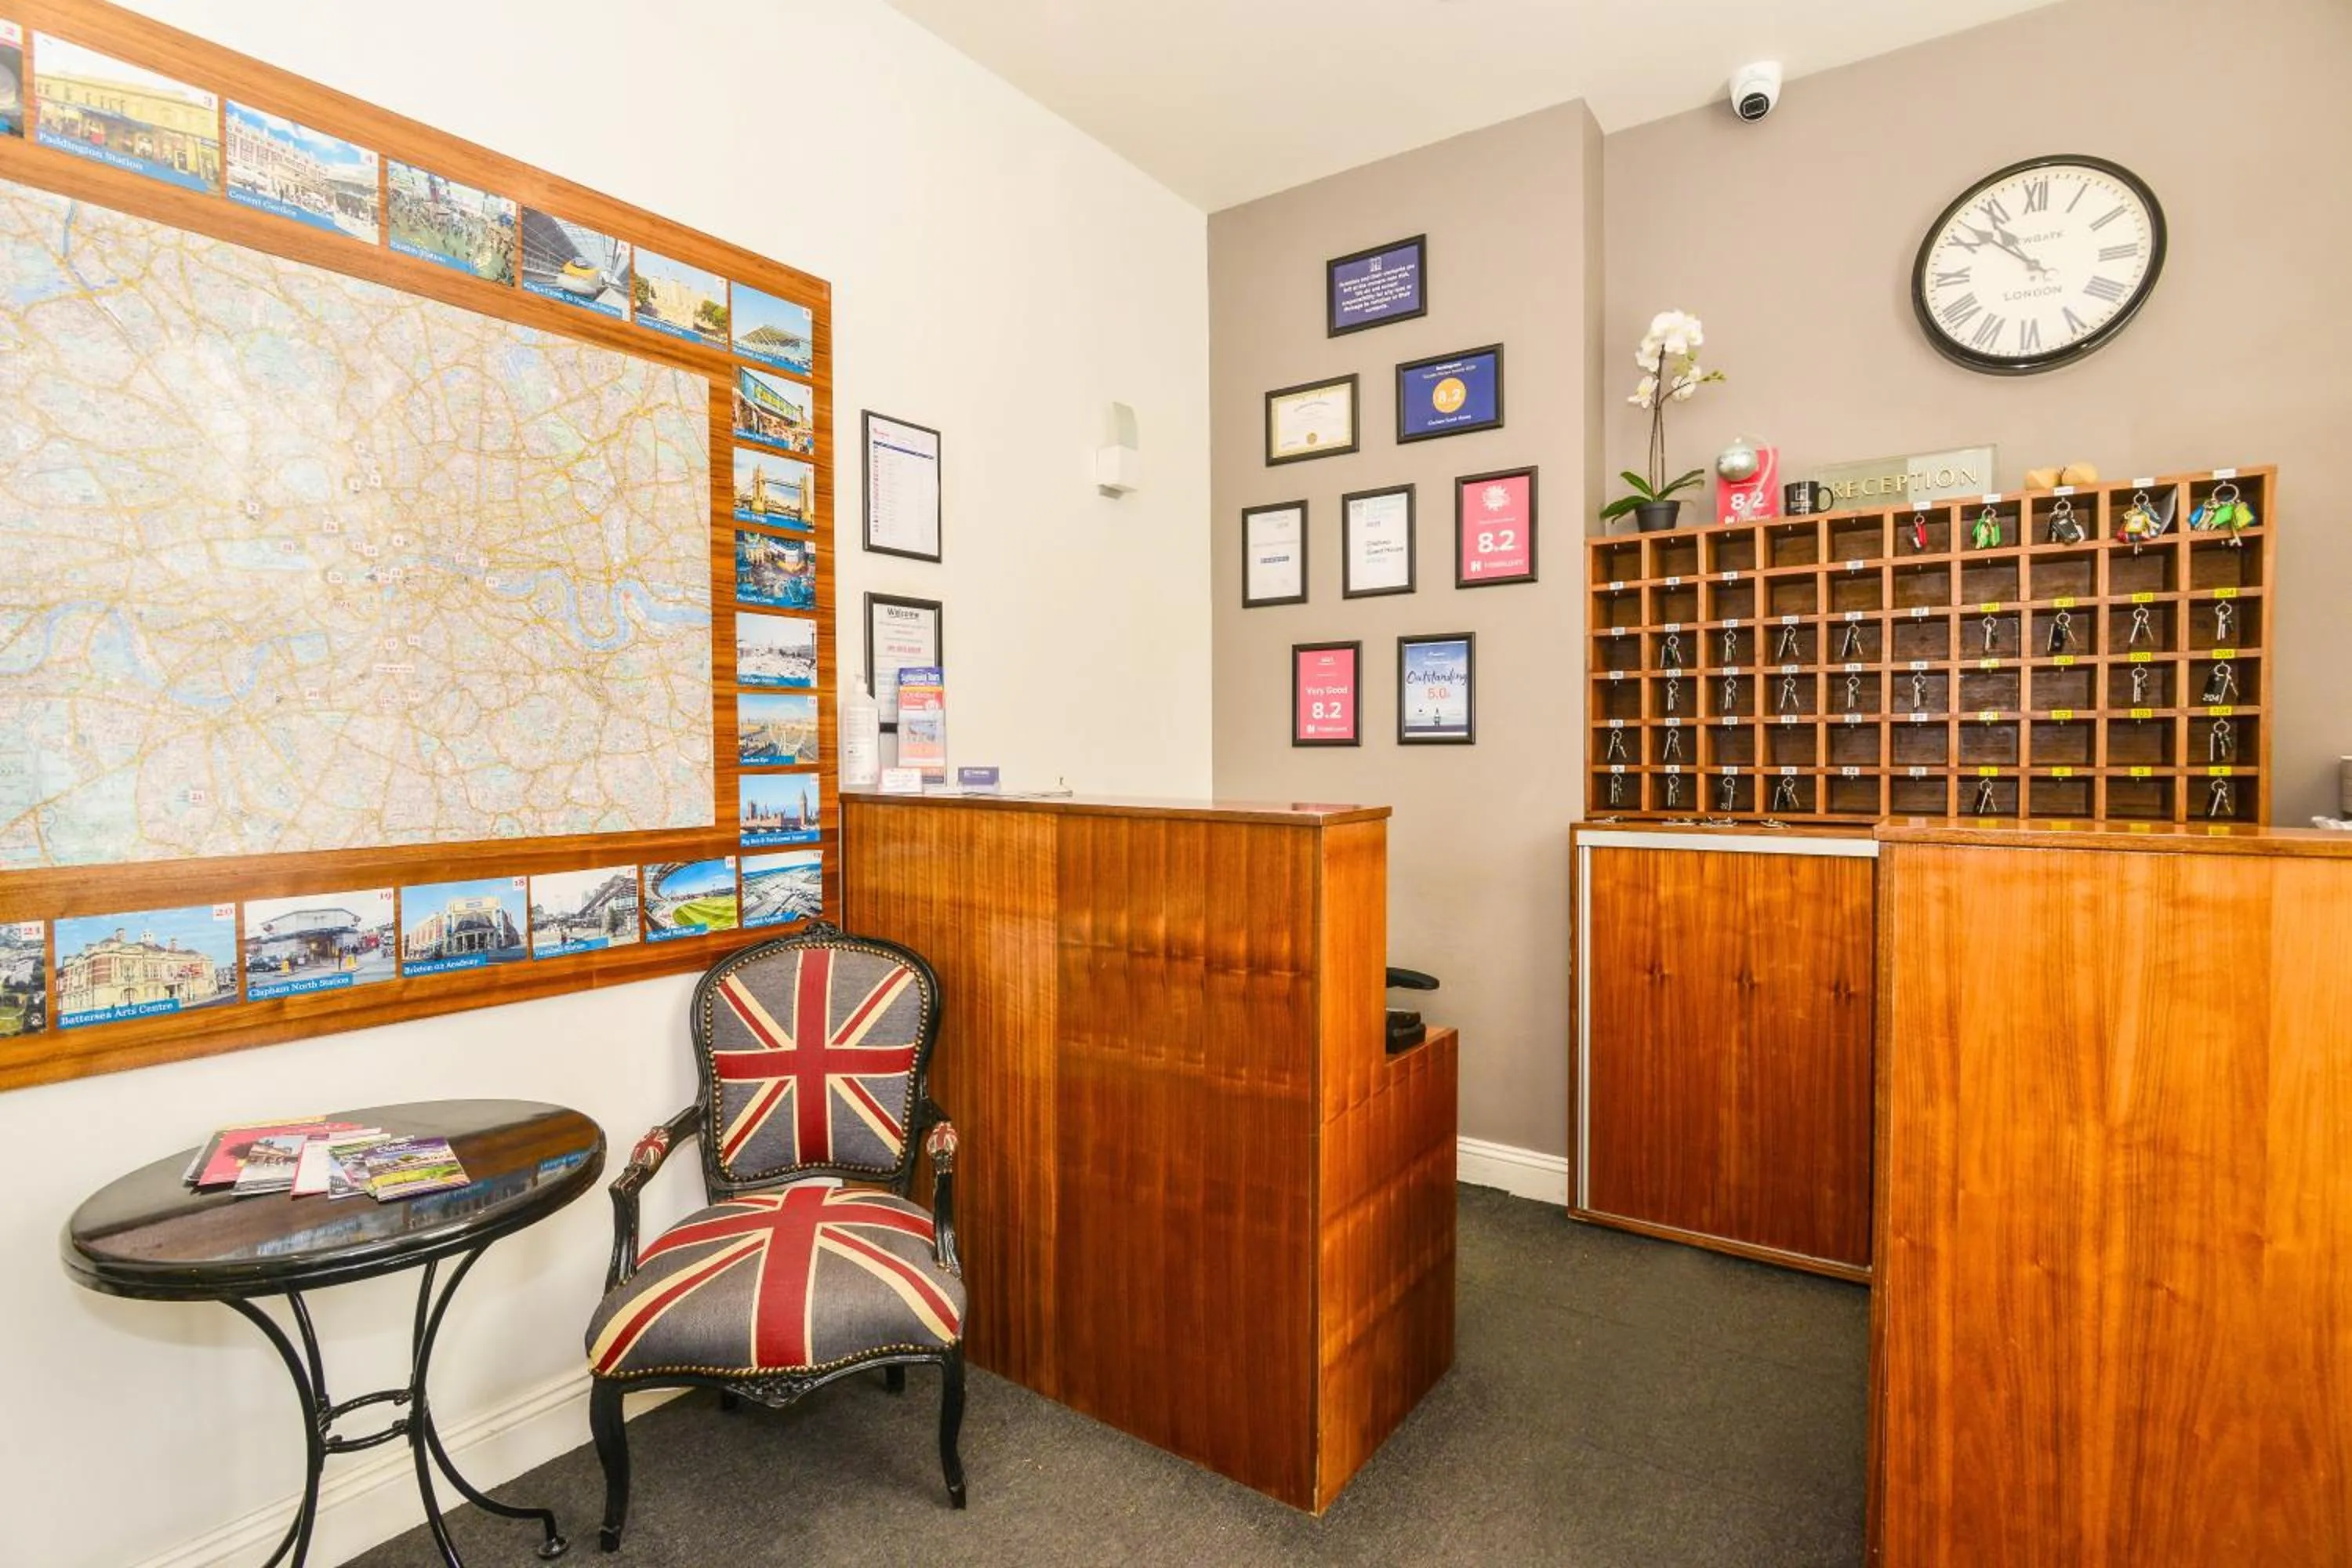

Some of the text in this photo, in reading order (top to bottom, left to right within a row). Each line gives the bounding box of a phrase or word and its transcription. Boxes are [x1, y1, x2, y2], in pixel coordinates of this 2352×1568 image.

[104, 151, 143, 171] Station
[2023, 180, 2049, 216] XII
[2004, 285, 2063, 301] LONDON
[1831, 466, 1978, 500] RECEPTION
[1730, 491, 1765, 511] 82
[1478, 528, 1515, 554] 8.2
[887, 608, 920, 619] Welcome
[1406, 667, 1468, 686] Outstanding
[1305, 685, 1349, 696] Very Good
[2201, 693, 2220, 702] 204
[1312, 702, 1342, 720] 8.2
[514, 878, 524, 887] 18
[249, 975, 350, 998] Clapham North Station
[61, 1001, 173, 1026] Battersea Arts Centre
